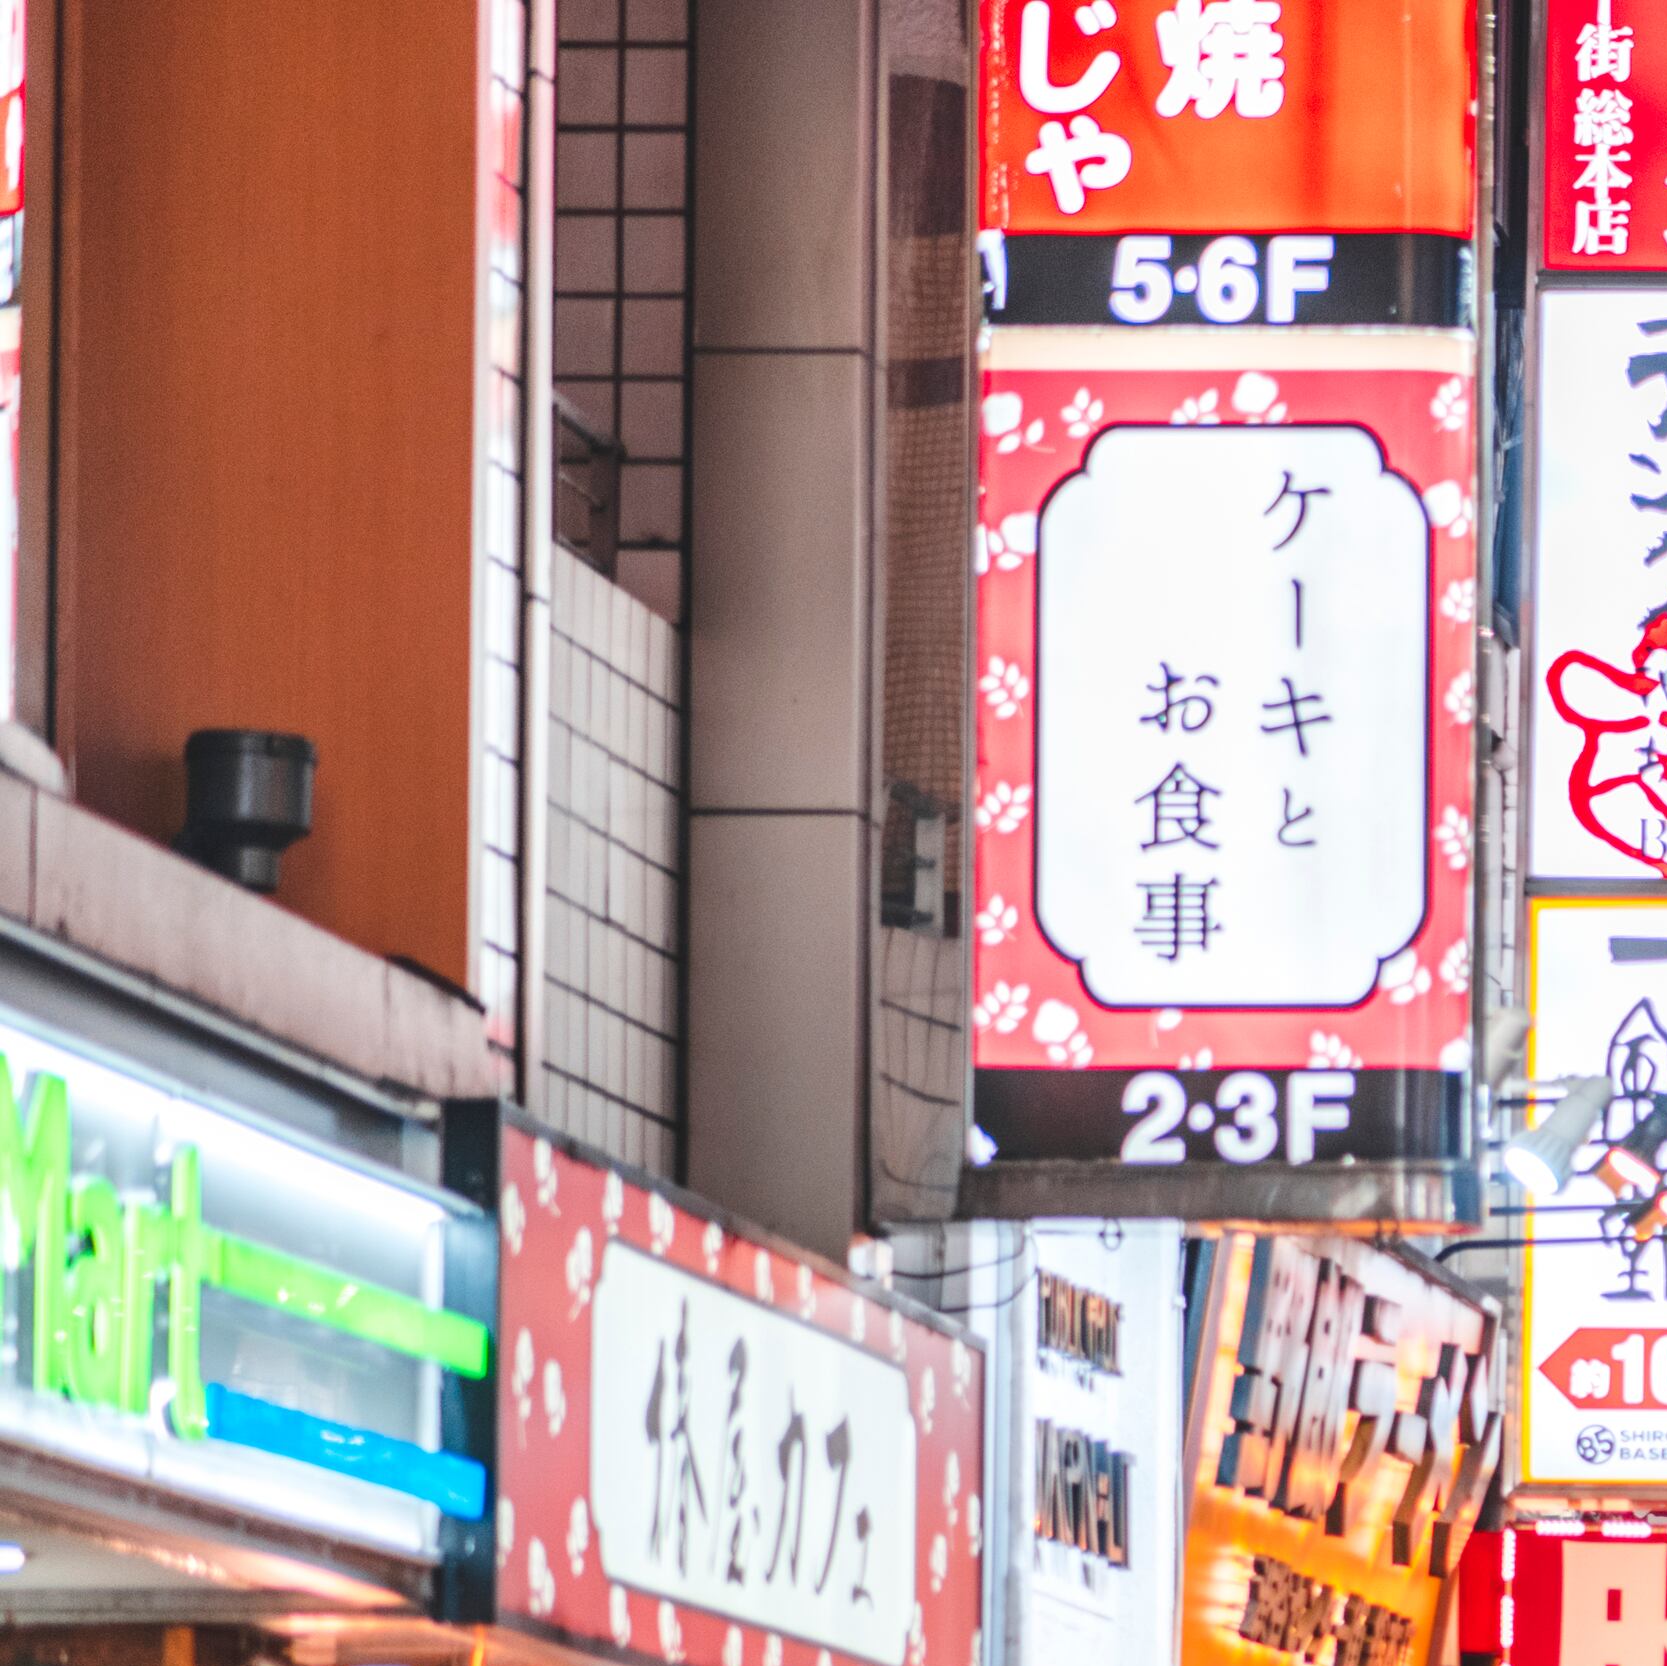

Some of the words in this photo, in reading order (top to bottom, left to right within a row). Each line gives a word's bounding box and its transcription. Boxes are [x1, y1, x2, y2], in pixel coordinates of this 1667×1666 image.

[1155, 0, 1285, 118] 焼
[1261, 470, 1333, 848] ケーキと
[1132, 660, 1225, 960] お食事
